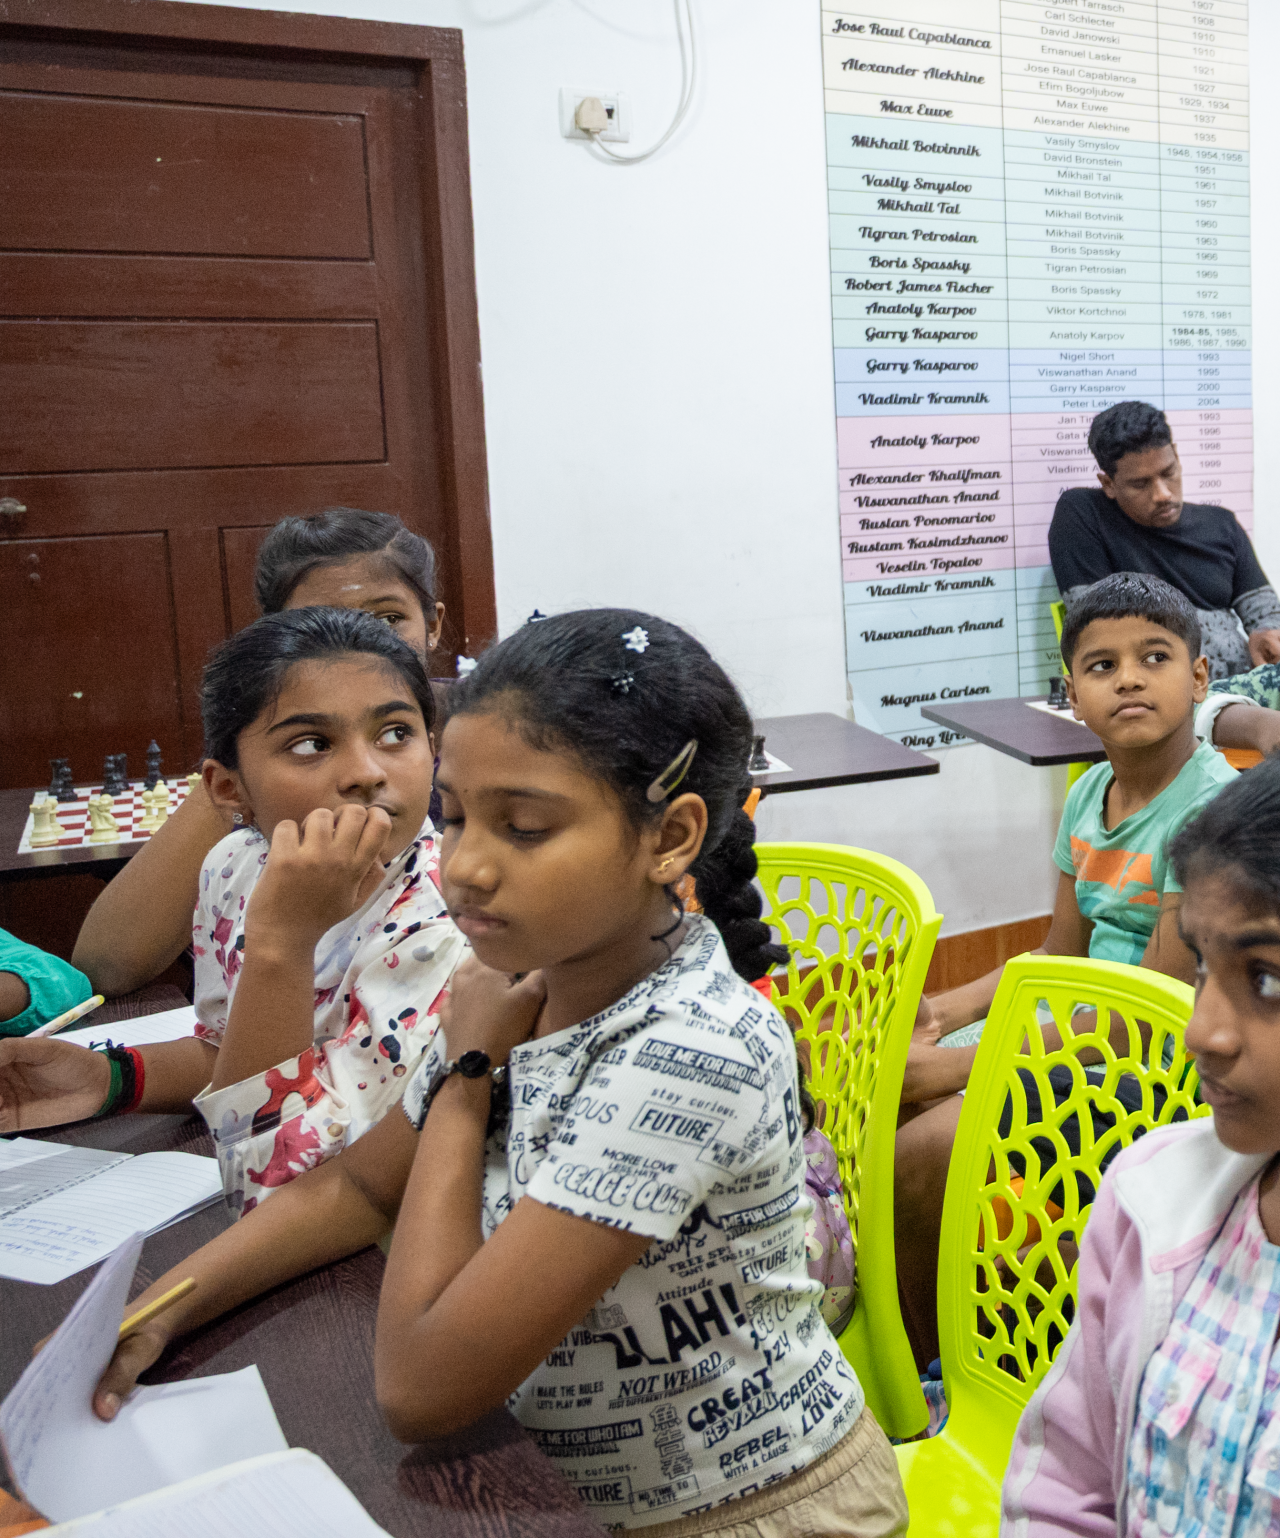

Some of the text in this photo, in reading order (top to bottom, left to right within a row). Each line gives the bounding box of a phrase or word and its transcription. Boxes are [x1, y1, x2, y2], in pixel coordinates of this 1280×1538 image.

[832, 18, 992, 49] Jose Raul Capablanca
[841, 58, 985, 84] Alexander Alekhine
[1193, 83, 1215, 93] 1927
[880, 100, 953, 118] Max Euwe
[1056, 100, 1108, 112] Max Euwe
[1034, 115, 1130, 133] Alexander Alekhine
[1194, 115, 1216, 124] 1937
[1045, 136, 1120, 151] Vasily Smyslov
[1194, 132, 1216, 142] 1935
[851, 135, 981, 157] Mikhail Botvinnik
[1044, 152, 1123, 167] David Bronstein
[1057, 169, 1111, 182] Mikhail Tal
[1195, 166, 1216, 175] 1951
[862, 174, 972, 194] Vasily Smyslov
[1195, 181, 1216, 190] 1961
[877, 198, 961, 214] Mikhail Tal
[1195, 199, 1217, 208] 1957
[858, 226, 979, 244] Tigran Petrosian
[1195, 237, 1218, 246] 1963
[1050, 245, 1121, 258] Boris Spassky
[869, 255, 972, 274] Boris Spassky
[1045, 263, 1126, 275] Tigran Petrosian
[845, 278, 994, 294] Robert James Fischer
[1051, 285, 1122, 298] Boris Spassky
[1196, 291, 1218, 299] 1972
[865, 302, 977, 318] Anatoly Karpov
[865, 327, 978, 343] Garry Kasparov
[1050, 331, 1125, 342] Anatoly Karpov
[1060, 352, 1115, 363] Nigel Short
[1197, 353, 1220, 361] 1993
[866, 359, 979, 374] Garry Kasparov
[1038, 368, 1137, 377] Viswanathan Anand
[1197, 368, 1220, 376] 1995
[1050, 384, 1126, 394] Garry Kasparov
[1197, 383, 1220, 391] 2000
[858, 392, 990, 405] Vladimir Kramnik
[1198, 398, 1220, 406] 2004
[1198, 413, 1220, 421] 1993
[870, 433, 980, 449] Anatoly Karpov
[1056, 431, 1080, 440] Gata
[849, 468, 1002, 487] Alexander Khalifman
[1047, 465, 1089, 474] Vladimir
[1199, 480, 1222, 488] 2000
[854, 489, 1001, 508] Viswanathan Anand
[859, 512, 996, 531] Ruslan Ponomariov
[847, 534, 1009, 554] Rustam Kasimdzhanov
[876, 556, 983, 574] Veselin Topalov
[866, 576, 996, 597] Vladimir Kramnik
[860, 618, 1005, 643] Viswanathan Anand
[880, 685, 992, 707] Magnus Carlsen
[901, 735, 936, 747] Ding
[645, 1040, 678, 1060] LOVE
[677, 1048, 698, 1065] ME
[695, 1053, 724, 1073] FOR
[722, 1060, 748, 1080] WHO
[651, 1088, 738, 1119] stay curious.
[640, 1108, 713, 1142] FUTURE
[601, 1148, 678, 1174] MORE LOVE
[554, 1163, 634, 1207] PEACE
[741, 1245, 788, 1284] FUTURE
[656, 1277, 714, 1305] Attitude
[546, 1351, 576, 1367] ONLY
[618, 1350, 722, 1398] NOT WEIRD
[778, 1349, 833, 1412] CREATED
[537, 1383, 556, 1398] MAKE
[560, 1383, 576, 1396] THE
[579, 1381, 604, 1395] RULES
[801, 1379, 831, 1412] WITH
[555, 1398, 574, 1409] PLAY
[802, 1384, 843, 1437] LOVE
[546, 1432, 563, 1445] ME
[563, 1430, 587, 1444] FOR
[587, 1426, 615, 1442] WHO
[620, 1421, 640, 1439] AM
[719, 1426, 790, 1469] REBEL
[724, 1441, 790, 1479] WITH A CAUSE
[676, 1481, 689, 1491] TO
